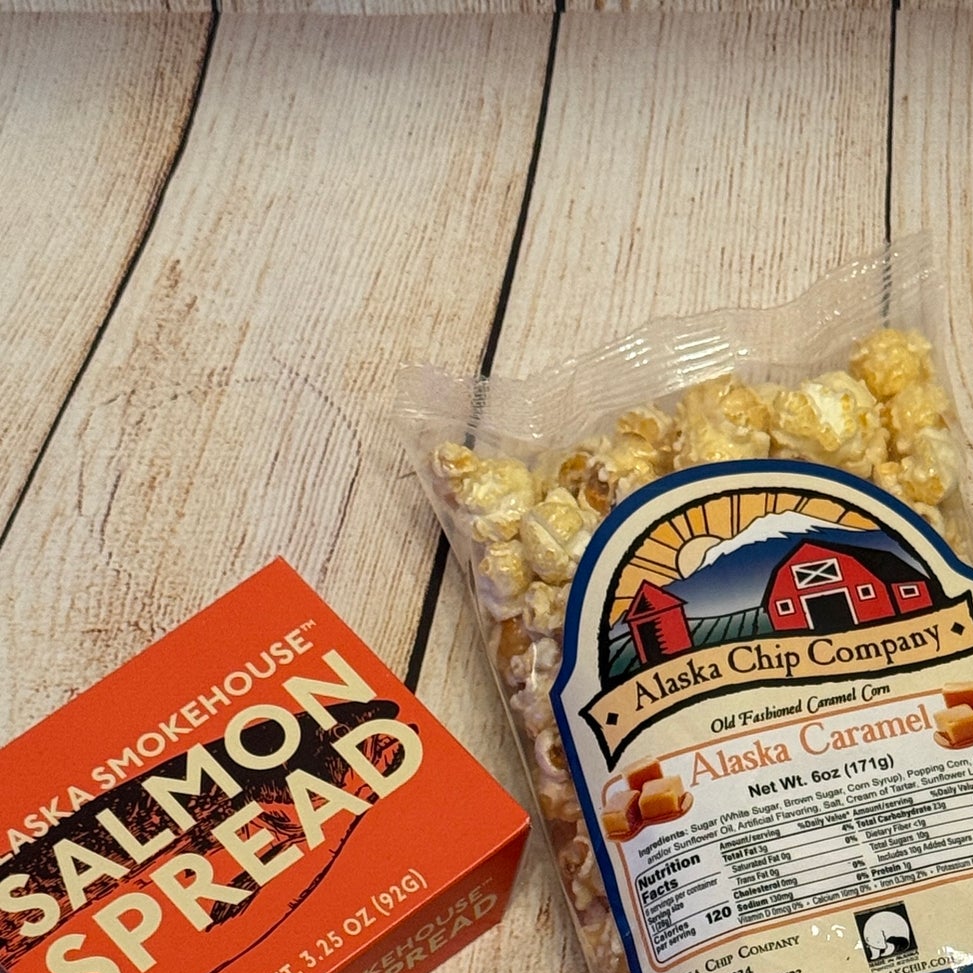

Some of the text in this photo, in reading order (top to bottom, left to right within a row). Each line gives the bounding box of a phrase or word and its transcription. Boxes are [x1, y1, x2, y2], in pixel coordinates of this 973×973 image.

[635, 624, 942, 711] Alaska Chip Company
[710, 683, 891, 734] Old Fashioned Caramel Corn
[690, 703, 934, 788] Alaska Caramel
[0, 648, 377, 938] SALMON
[748, 753, 894, 798] Net Wt. 6oz (171g)
[0, 785, 96, 867] ASKA
[638, 828, 689, 859] Ingredients:
[690, 817, 718, 834] Sugar
[719, 808, 750, 825] (White
[752, 802, 782, 817] Sugar,
[784, 793, 814, 808] Brown
[815, 787, 849, 802] Sugar,
[847, 780, 870, 793] Corn
[872, 772, 905, 790] Syrup),
[906, 763, 945, 779] Popping
[946, 757, 972, 769] Corn,
[647, 848, 672, 865] and/or
[673, 828, 718, 852] Sunflower
[737, 816, 774, 830] Artificial
[776, 802, 821, 821] Flavoring,
[823, 798, 844, 810] Salt,
[848, 791, 879, 805] Cream
[879, 788, 891, 799] of
[921, 770, 966, 786] Sunflower
[853, 797, 914, 817] Amount/serving
[856, 816, 877, 829] Total
[878, 805, 932, 825] Carbohydrate
[719, 827, 781, 851] Amount/serving
[722, 851, 744, 863] Total
[744, 848, 758, 858] Fat
[638, 853, 701, 891] Nutrition
[641, 878, 678, 904] Facts
[733, 882, 781, 900] Cholesterol
[299, 930, 344, 969] 3.25
[343, 907, 376, 936] OZ
[375, 868, 428, 917] (92G)
[654, 906, 732, 944] Calories 120
[656, 928, 696, 955] per serving
[705, 955, 734, 972] CHIP
[738, 935, 800, 959] COMPANY
